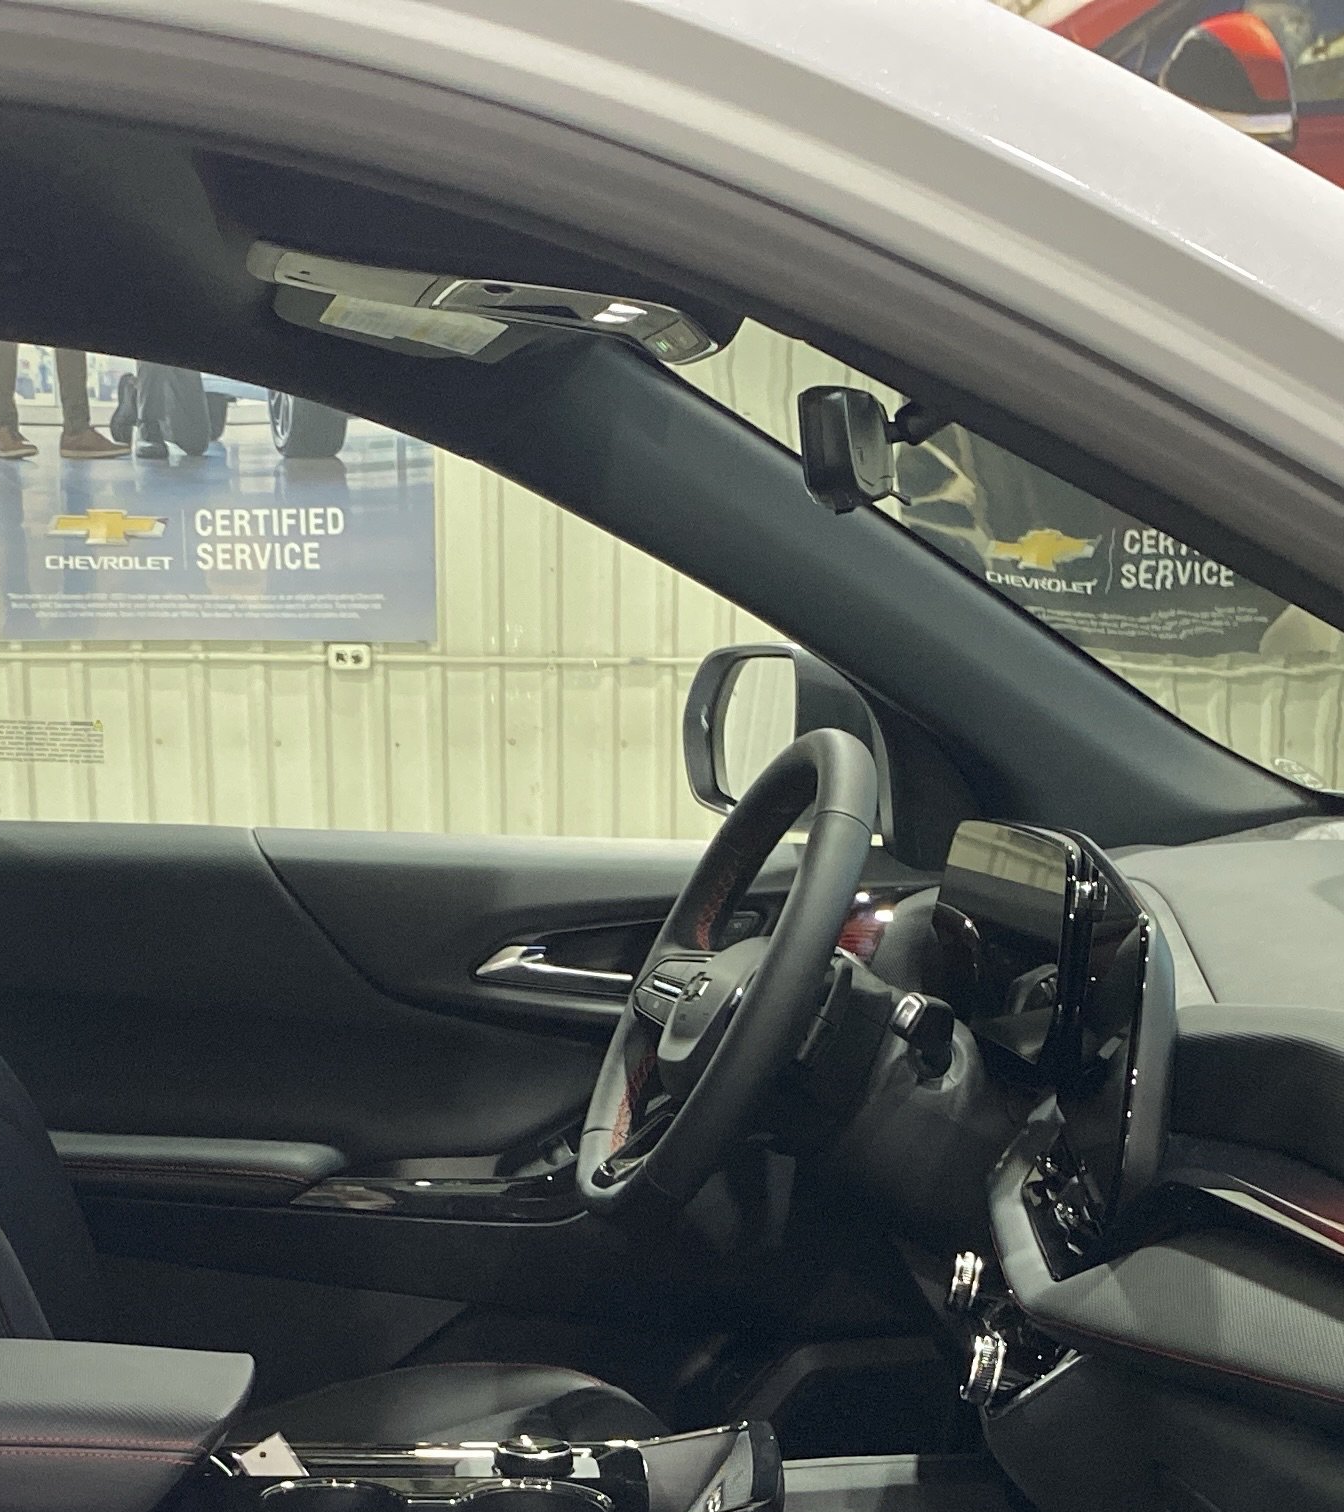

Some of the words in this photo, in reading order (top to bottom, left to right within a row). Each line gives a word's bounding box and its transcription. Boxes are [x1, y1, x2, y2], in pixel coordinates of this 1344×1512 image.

[195, 507, 345, 537] CERTIFIED
[1123, 528, 1201, 556] CER
[44, 555, 174, 571] CHEVROLET
[196, 542, 321, 571] SERVICE
[985, 570, 1098, 595] CHEVROLET
[1120, 558, 1235, 590] SERVICE
